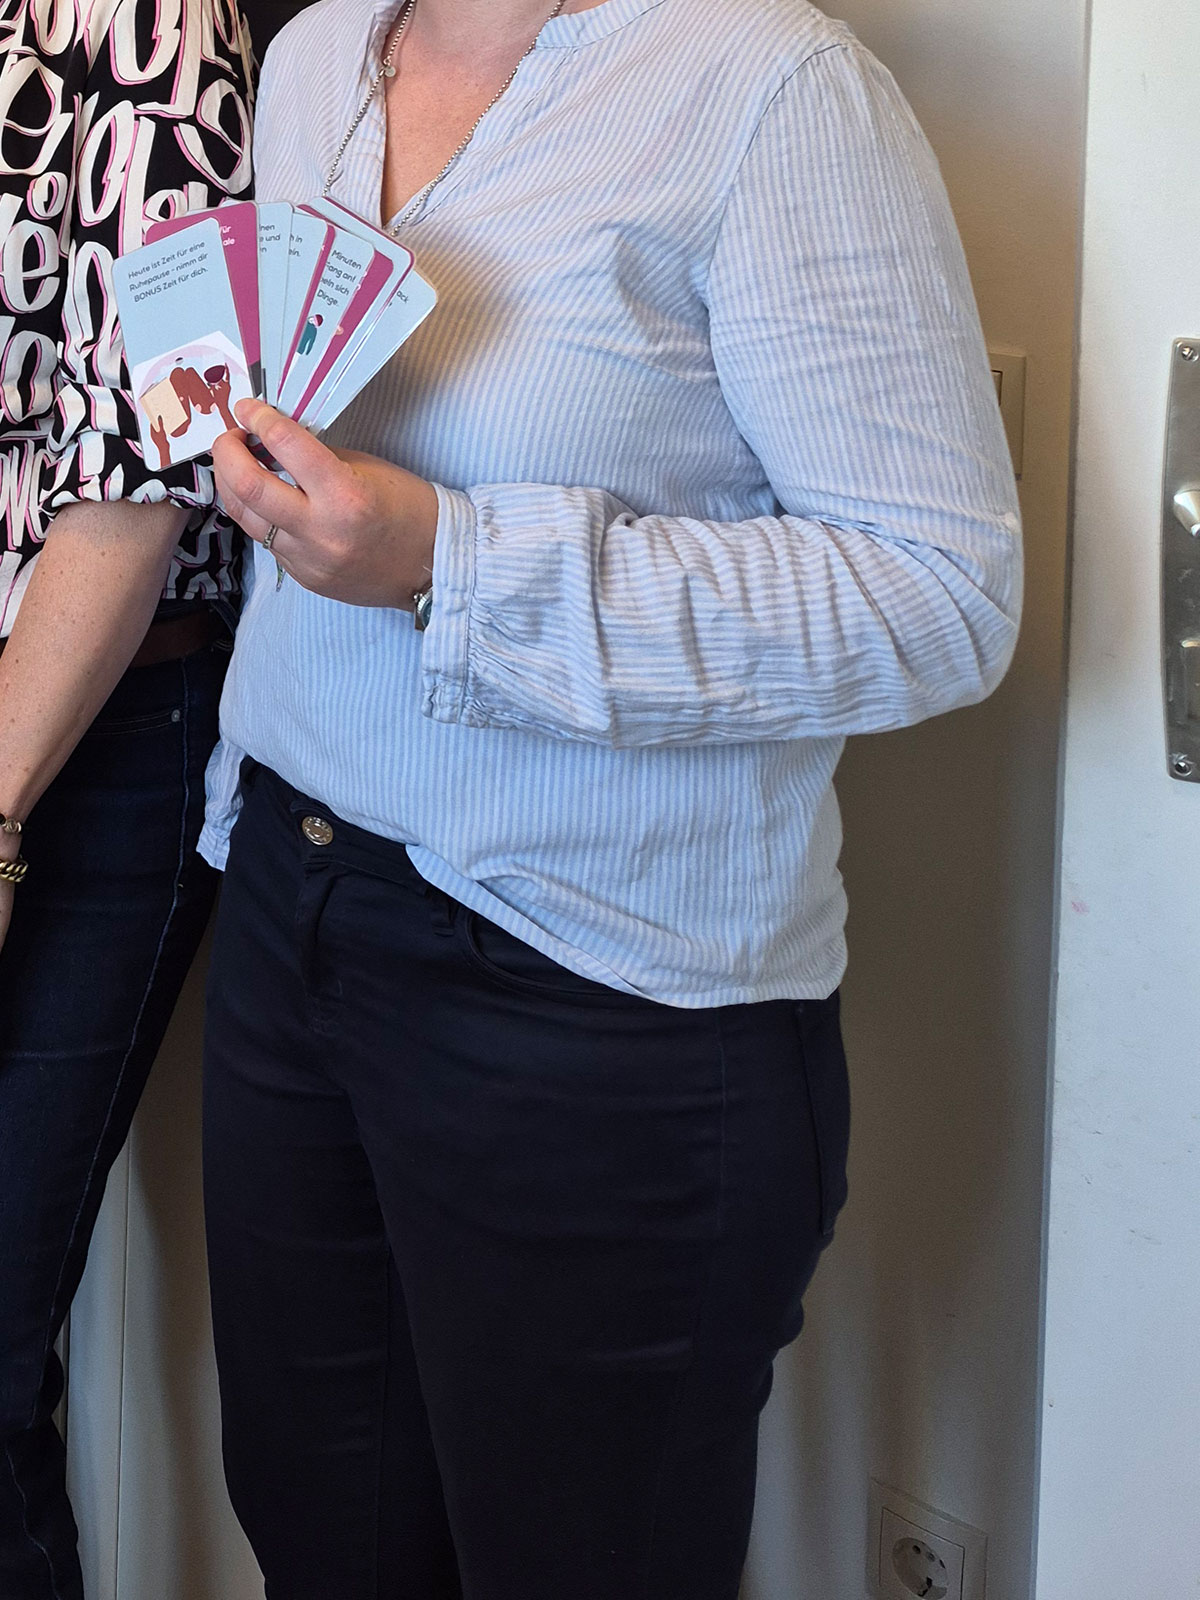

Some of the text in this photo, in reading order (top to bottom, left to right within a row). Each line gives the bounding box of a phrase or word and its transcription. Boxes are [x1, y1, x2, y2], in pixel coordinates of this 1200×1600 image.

[266, 233, 281, 242] und
[128, 265, 151, 279] Heute
[161, 254, 176, 265] Zeit
[176, 248, 188, 258] für
[189, 242, 205, 253] eine
[331, 249, 362, 270] Minuten
[129, 253, 208, 292] Ruhepause nimm dir
[134, 266, 208, 303] BONUS Zeit für dich.
[336, 284, 350, 296] sich
[316, 289, 339, 306] Dinge.
